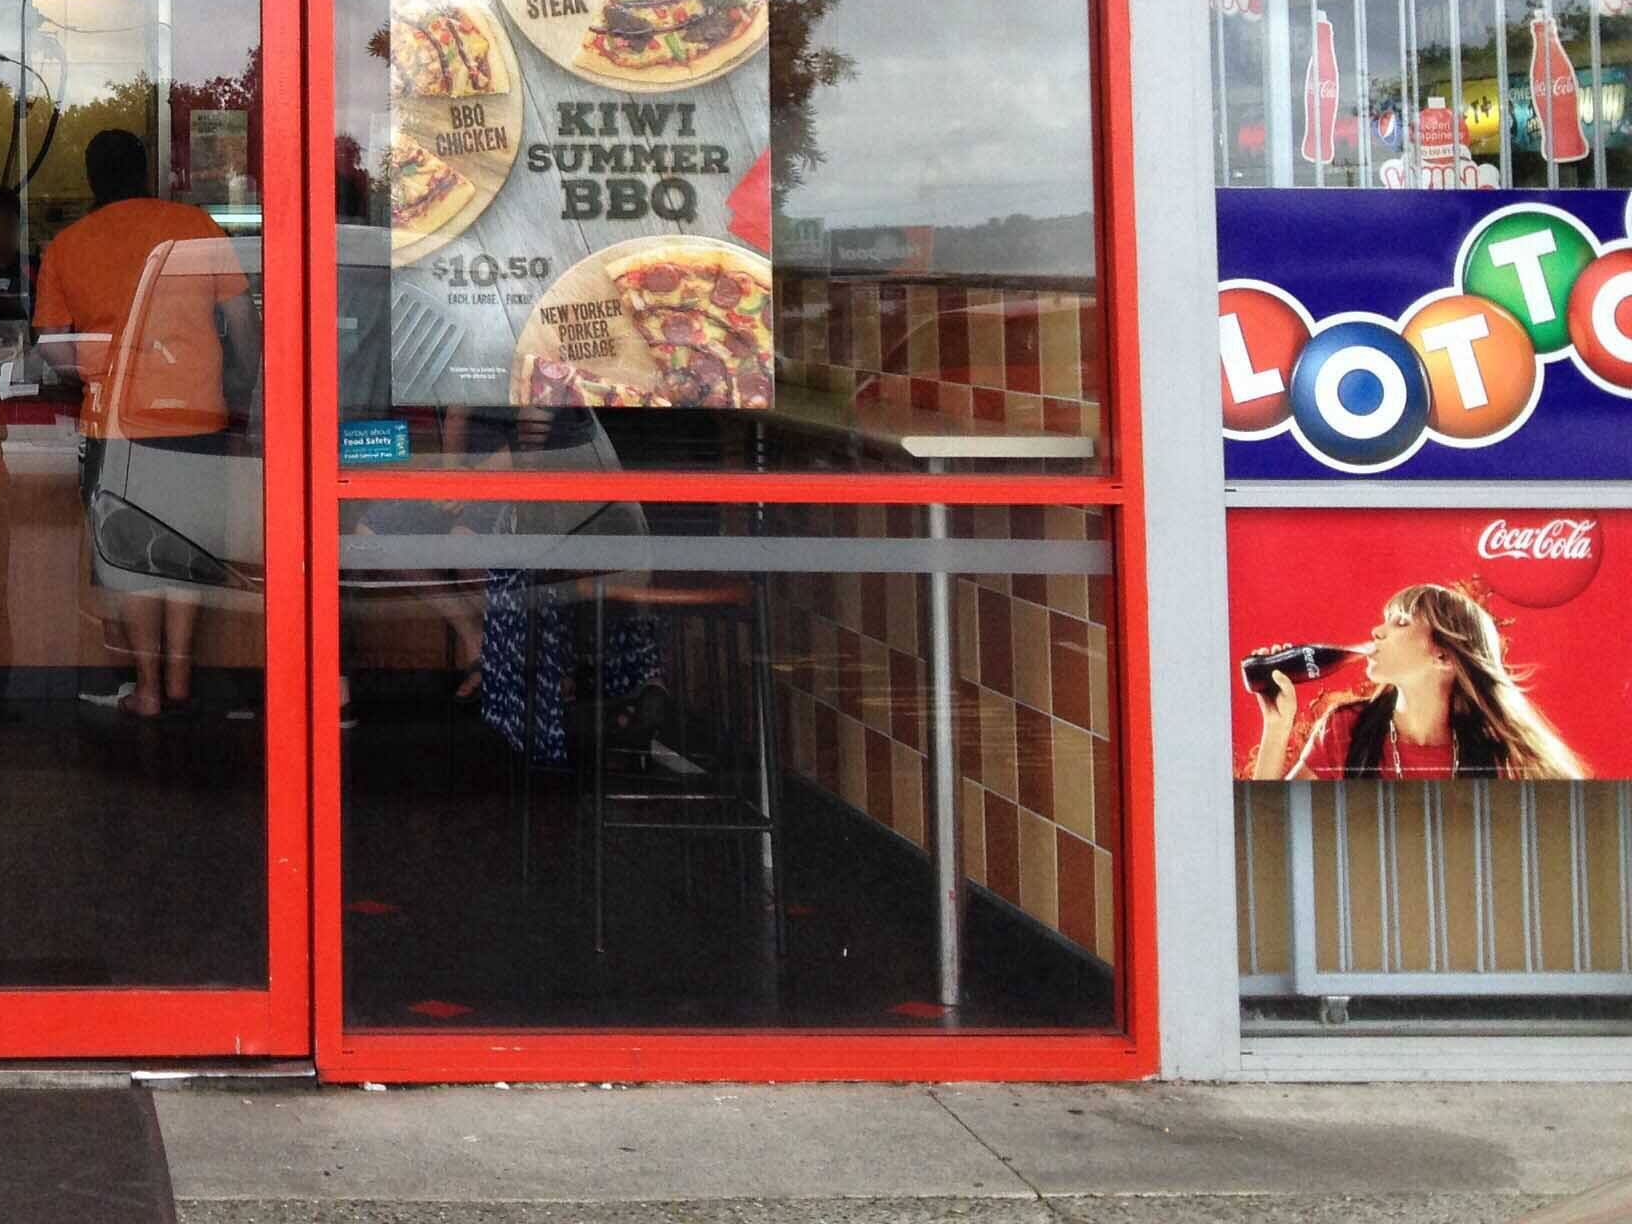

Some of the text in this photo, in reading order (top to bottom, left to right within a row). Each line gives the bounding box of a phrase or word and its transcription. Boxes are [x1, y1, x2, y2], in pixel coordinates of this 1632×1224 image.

[450, 104, 485, 129] BBQ
[557, 102, 696, 136] KIWI
[436, 127, 508, 157] CHICKEN
[528, 144, 730, 174] SUMMER
[561, 177, 698, 224] BBQ
[432, 253, 550, 287] $10.50
[540, 299, 623, 325] NEW YORKER
[559, 321, 609, 342] PORKER
[559, 339, 617, 362] SAUSAGE
[366, 436, 391, 446] Safety
[1478, 519, 1597, 559] Coca-Cola
